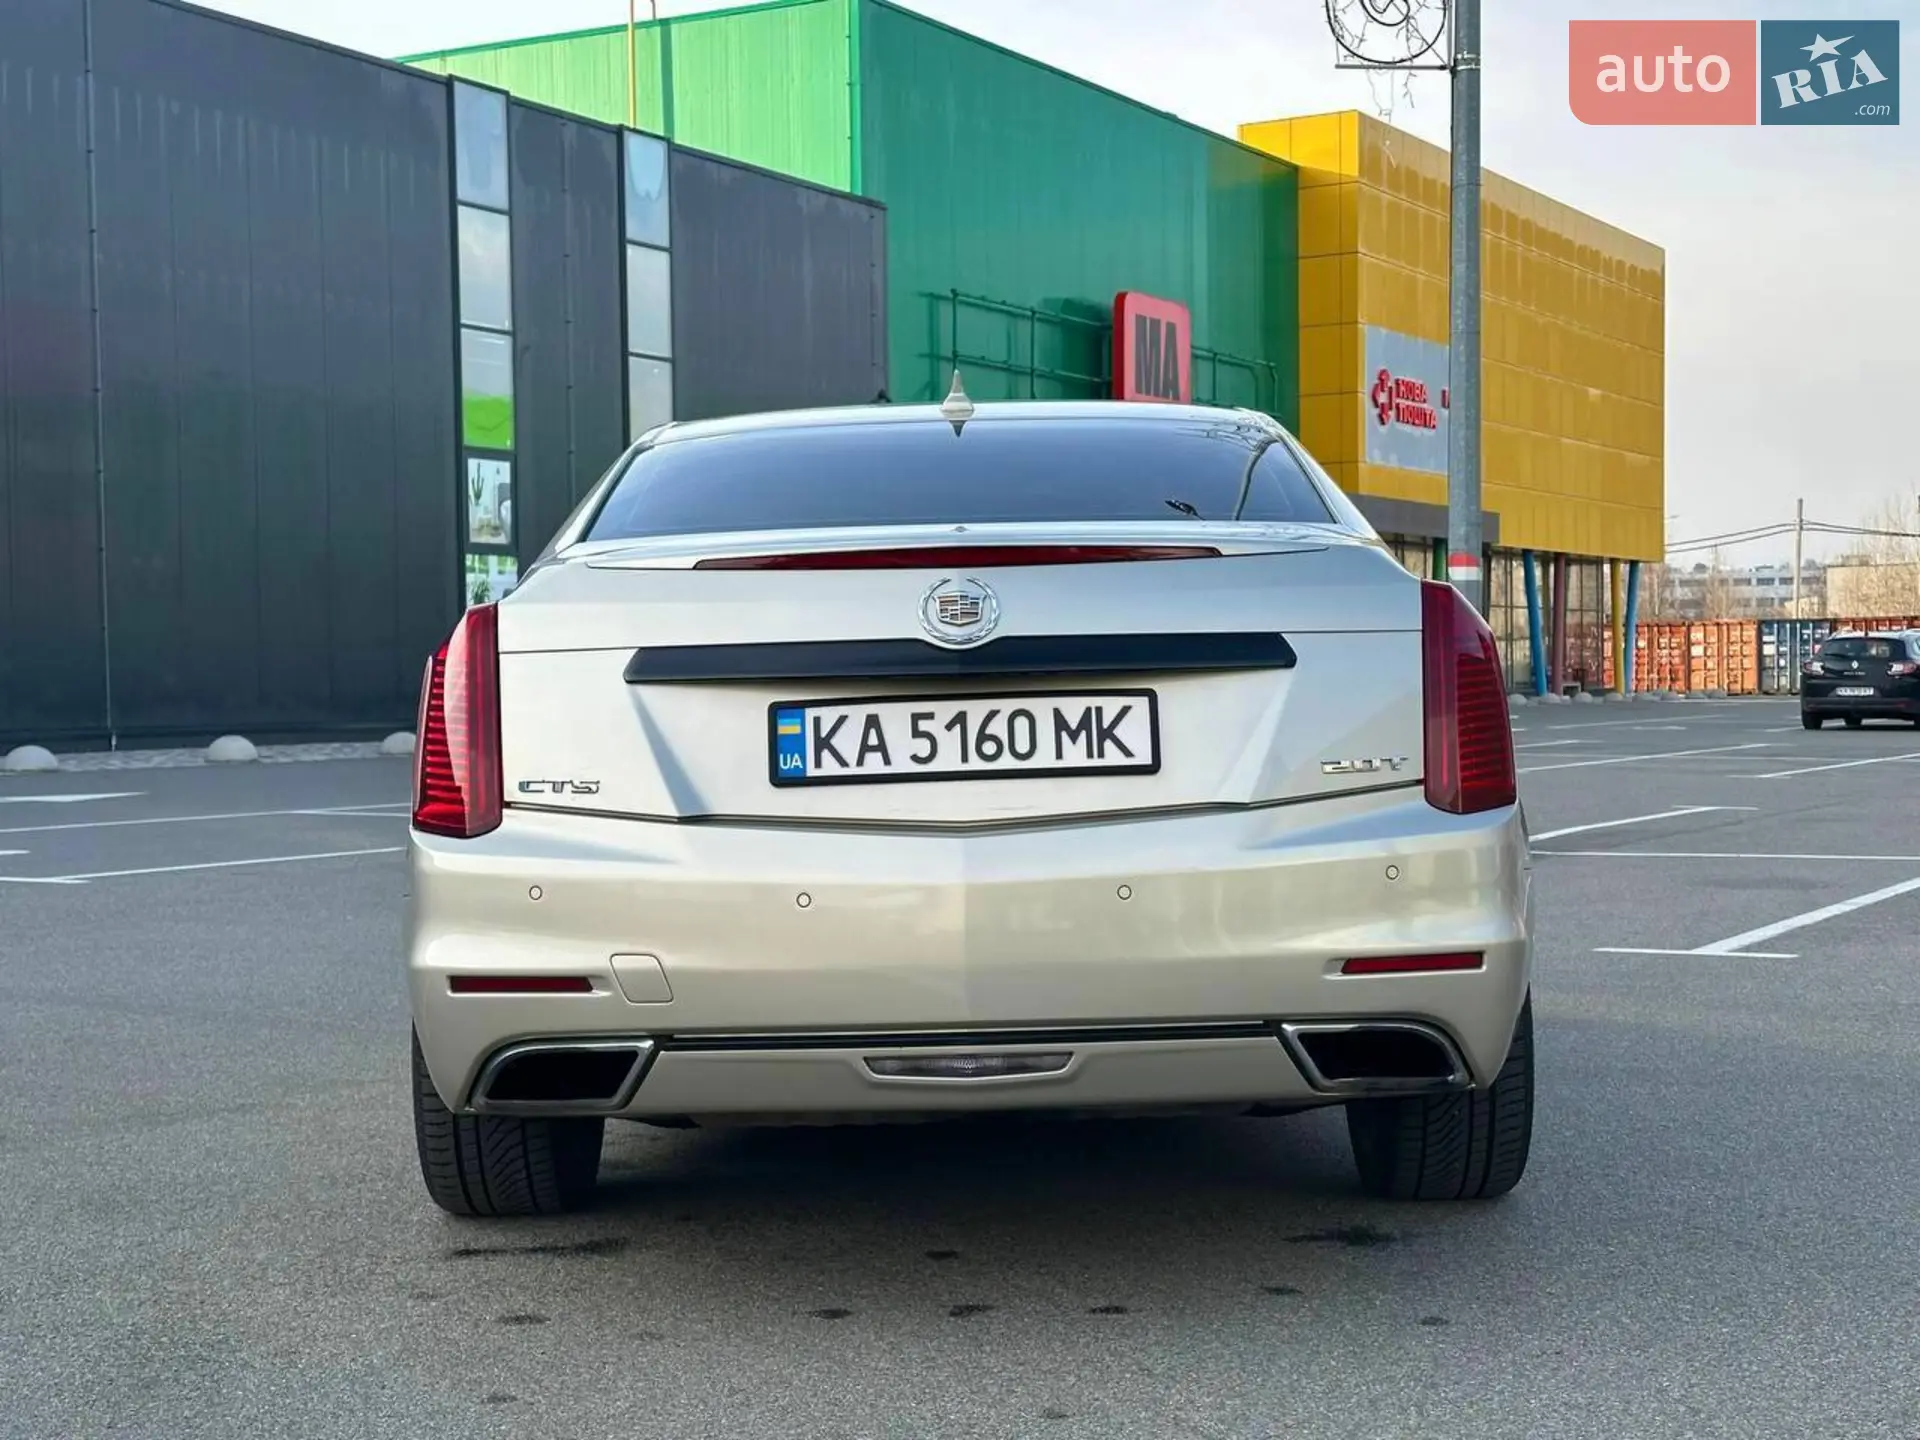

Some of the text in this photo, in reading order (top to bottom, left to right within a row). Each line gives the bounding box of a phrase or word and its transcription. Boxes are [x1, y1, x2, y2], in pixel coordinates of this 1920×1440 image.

[812, 705, 1135, 769] KA 5160 MK
[780, 753, 803, 770] UA
[518, 780, 600, 794] CTS
